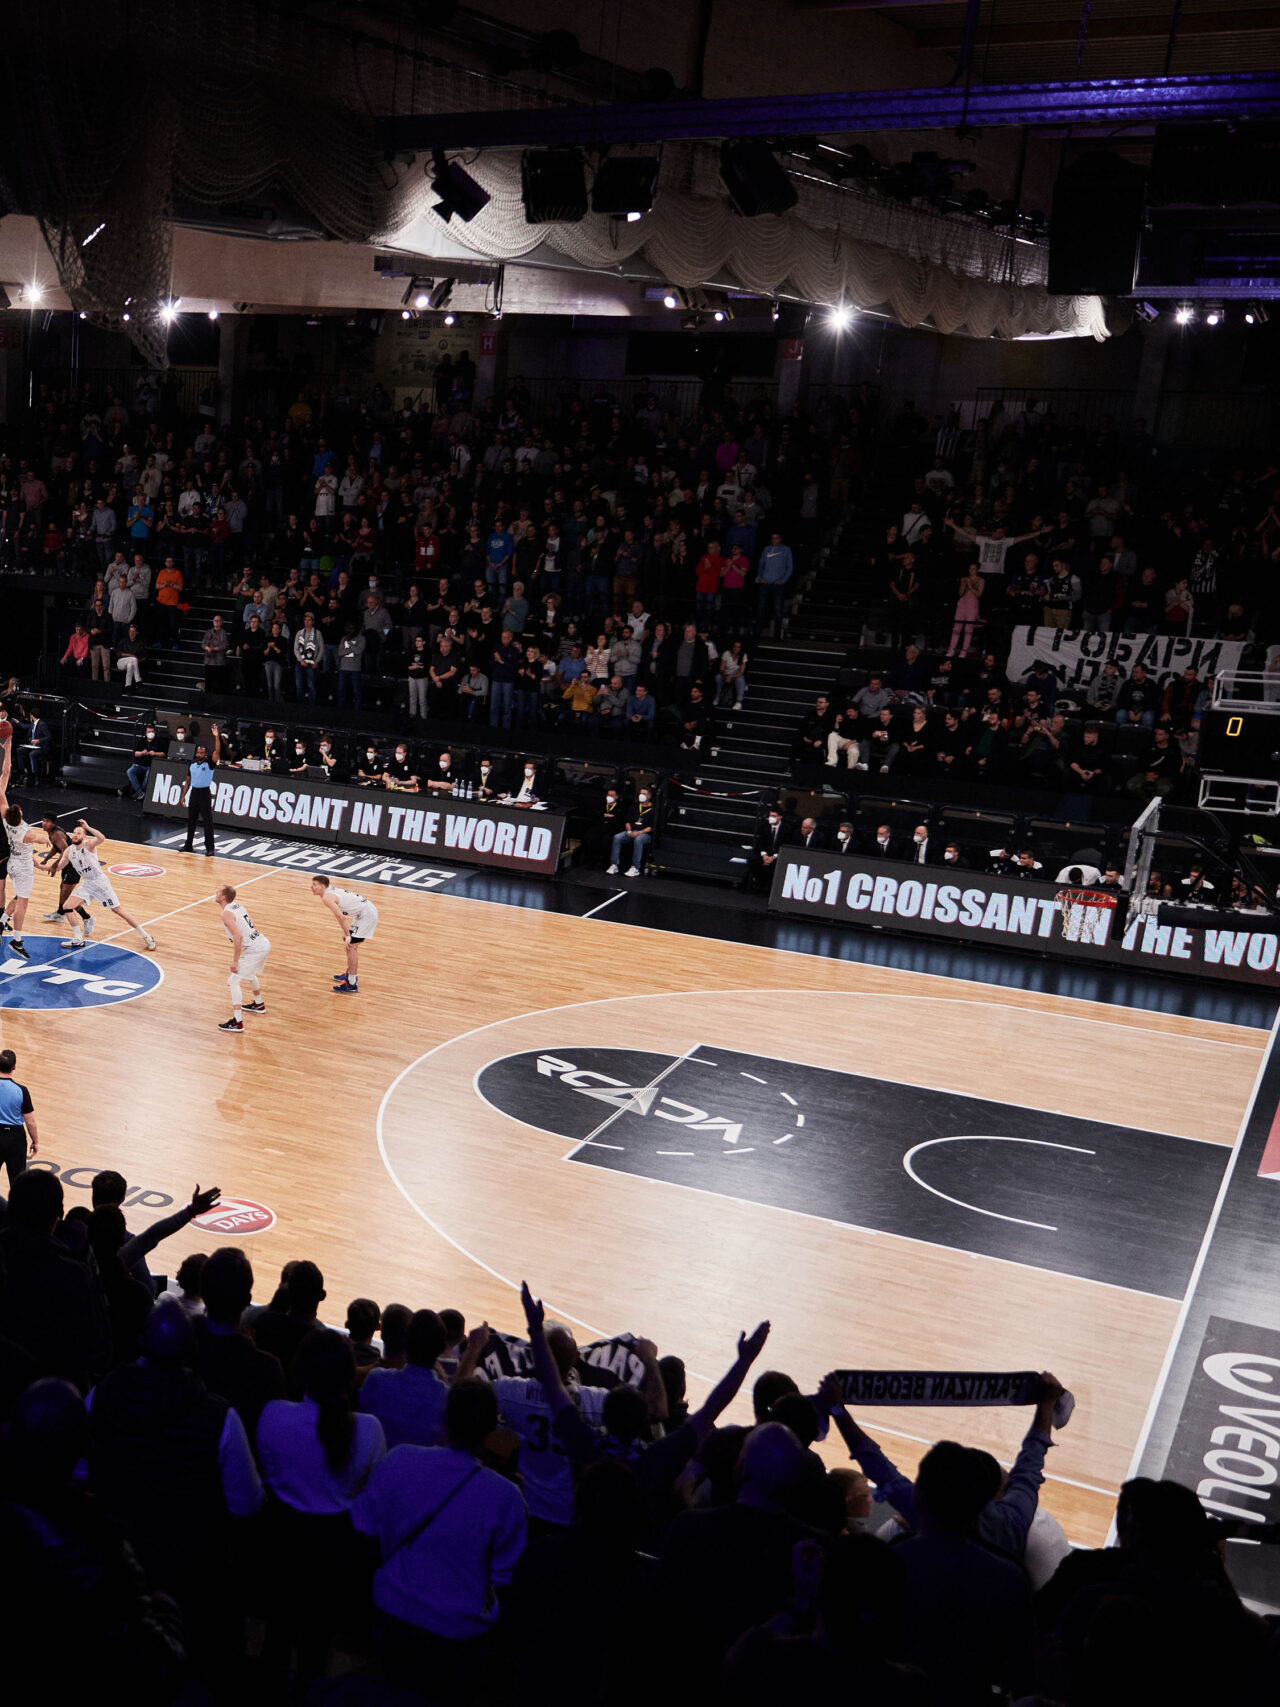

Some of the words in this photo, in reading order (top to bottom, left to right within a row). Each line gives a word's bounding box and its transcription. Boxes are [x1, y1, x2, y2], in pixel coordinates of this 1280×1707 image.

[1226, 716, 1244, 737] 0
[350, 803, 383, 837] IN
[387, 806, 440, 846] THE
[444, 813, 553, 862] WORLD
[352, 851, 402, 864] ARENA
[781, 863, 841, 906] No1
[846, 872, 1062, 939] CROISSANT
[1203, 929, 1280, 974] WO
[214, 1210, 269, 1230] DAYS
[1195, 1404, 1280, 1523] VEOLI
